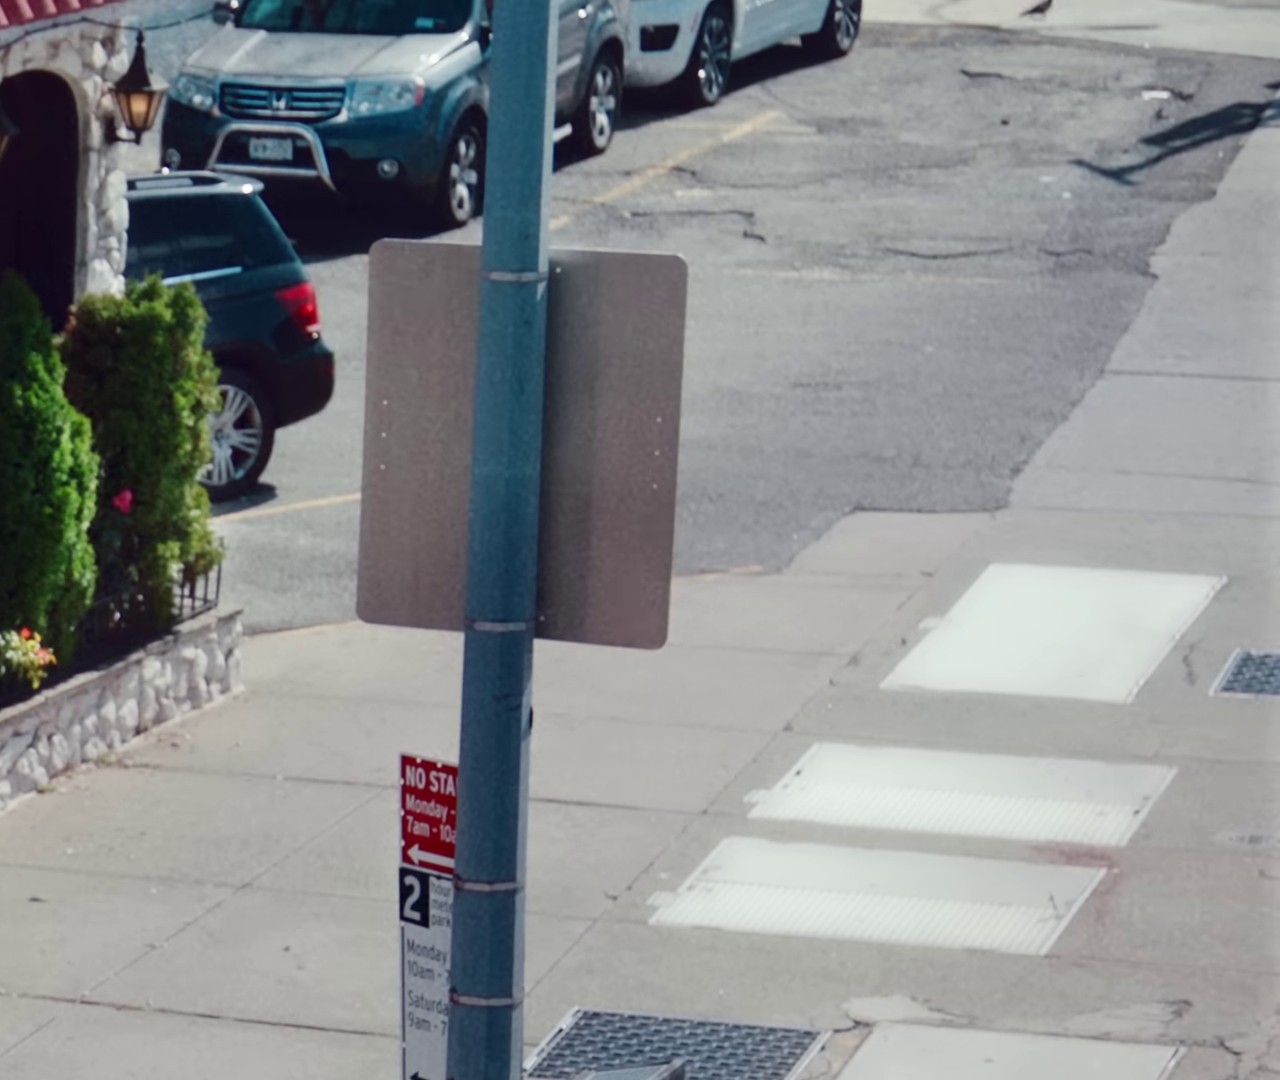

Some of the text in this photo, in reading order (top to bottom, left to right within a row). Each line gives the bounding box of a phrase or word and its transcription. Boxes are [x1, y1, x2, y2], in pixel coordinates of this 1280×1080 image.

[406, 764, 458, 797] NO STA
[406, 793, 448, 823] Monday
[406, 815, 430, 837] 7am
[403, 874, 421, 921] 2
[406, 938, 448, 966] Monday
[407, 959, 435, 982] 10am
[407, 1011, 431, 1032] 9am
[441, 1020, 448, 1037] 7
